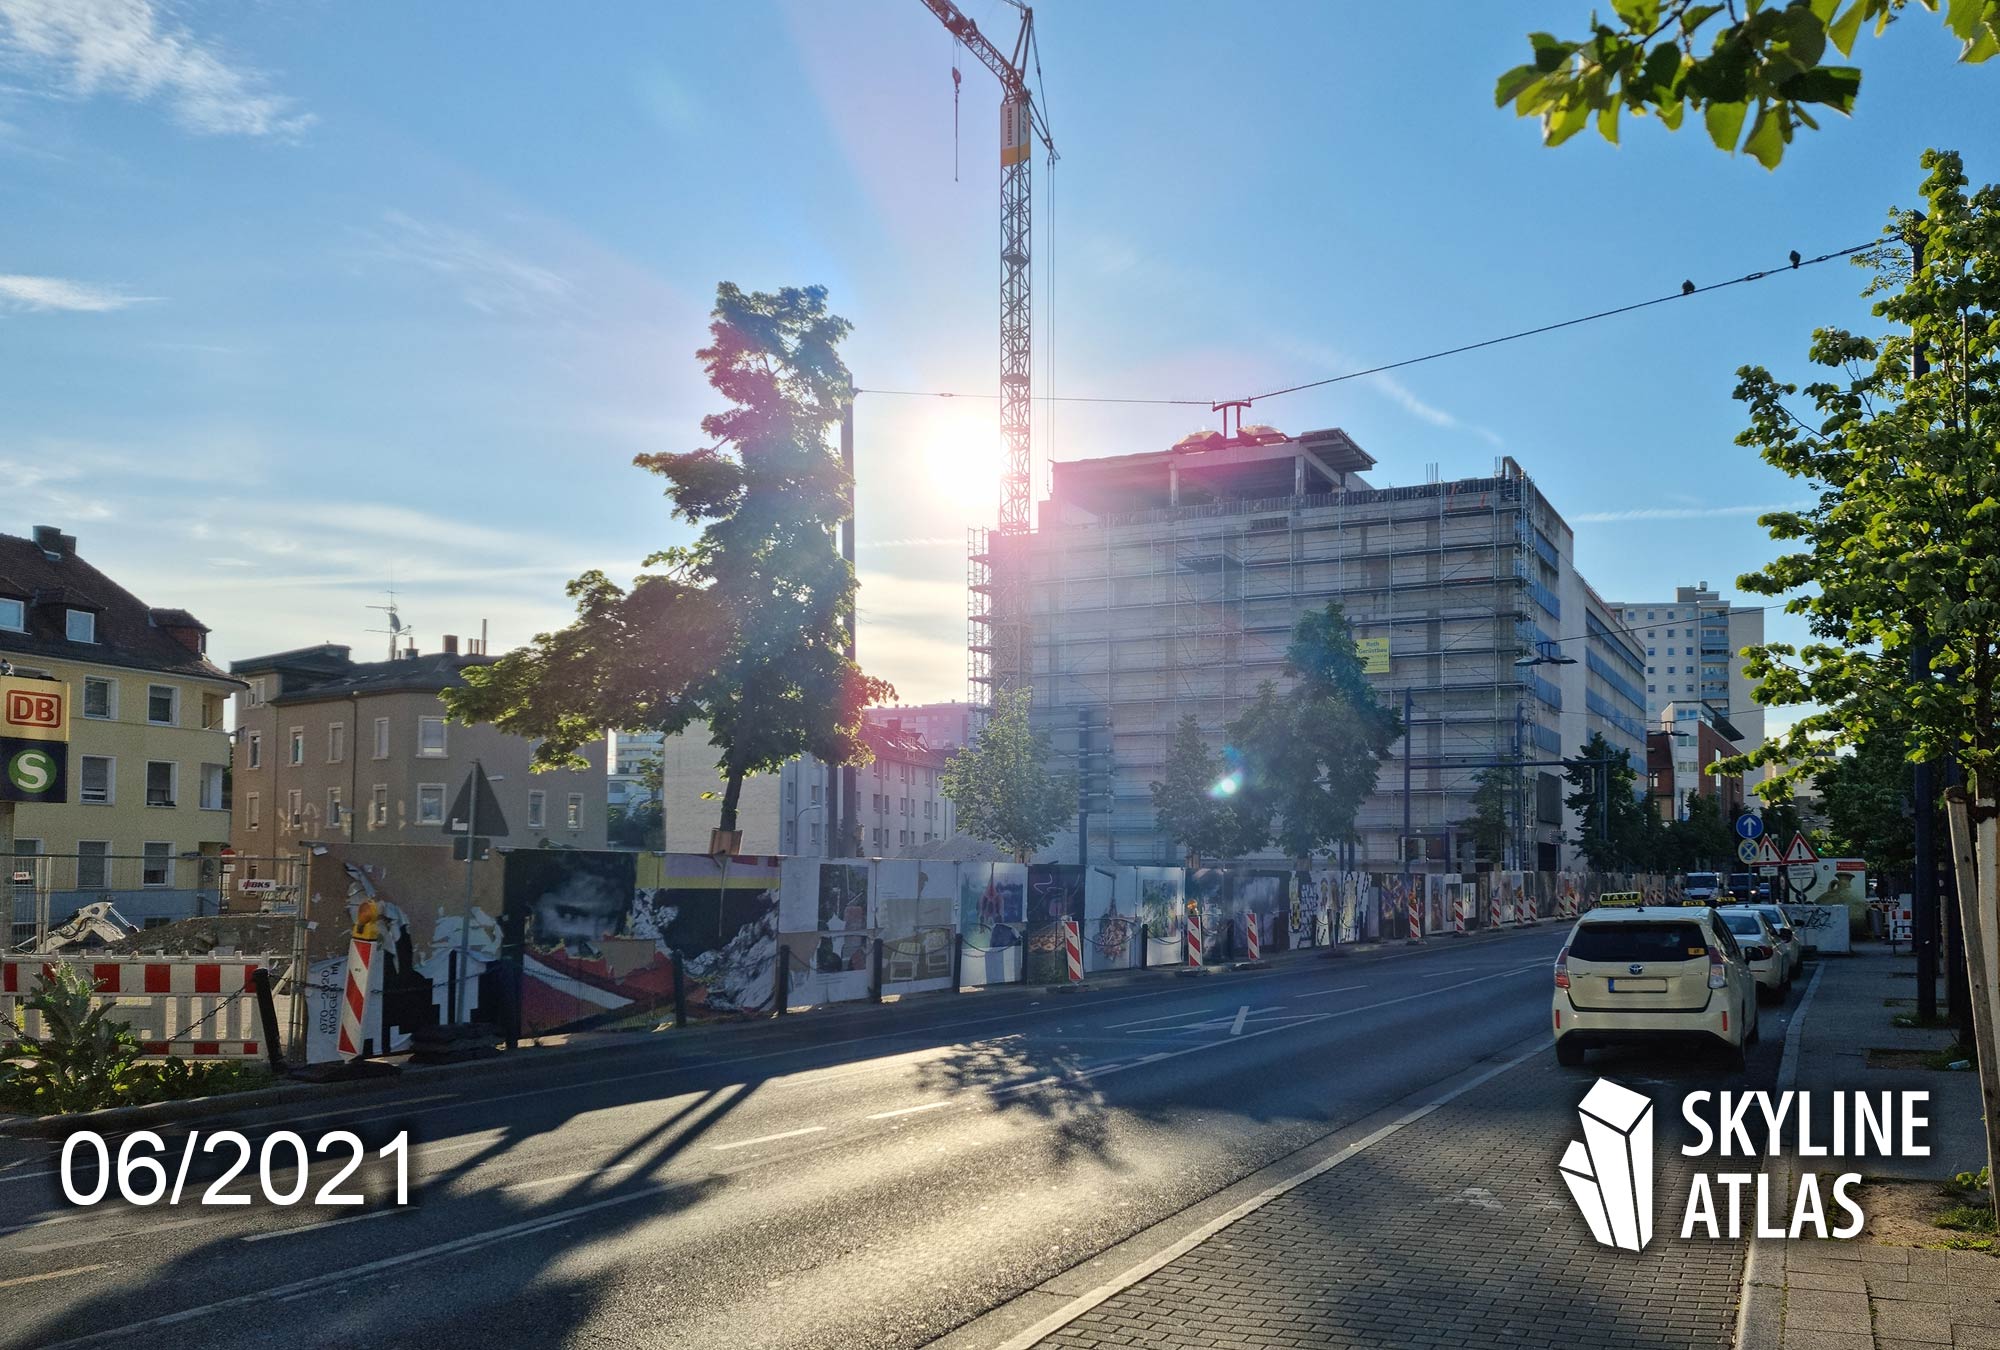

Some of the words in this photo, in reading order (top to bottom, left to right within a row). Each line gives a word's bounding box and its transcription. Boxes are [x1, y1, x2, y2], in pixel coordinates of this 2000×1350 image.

[13, 695, 55, 722] DB
[17, 753, 48, 789] S
[1606, 892, 1635, 901] TAXI
